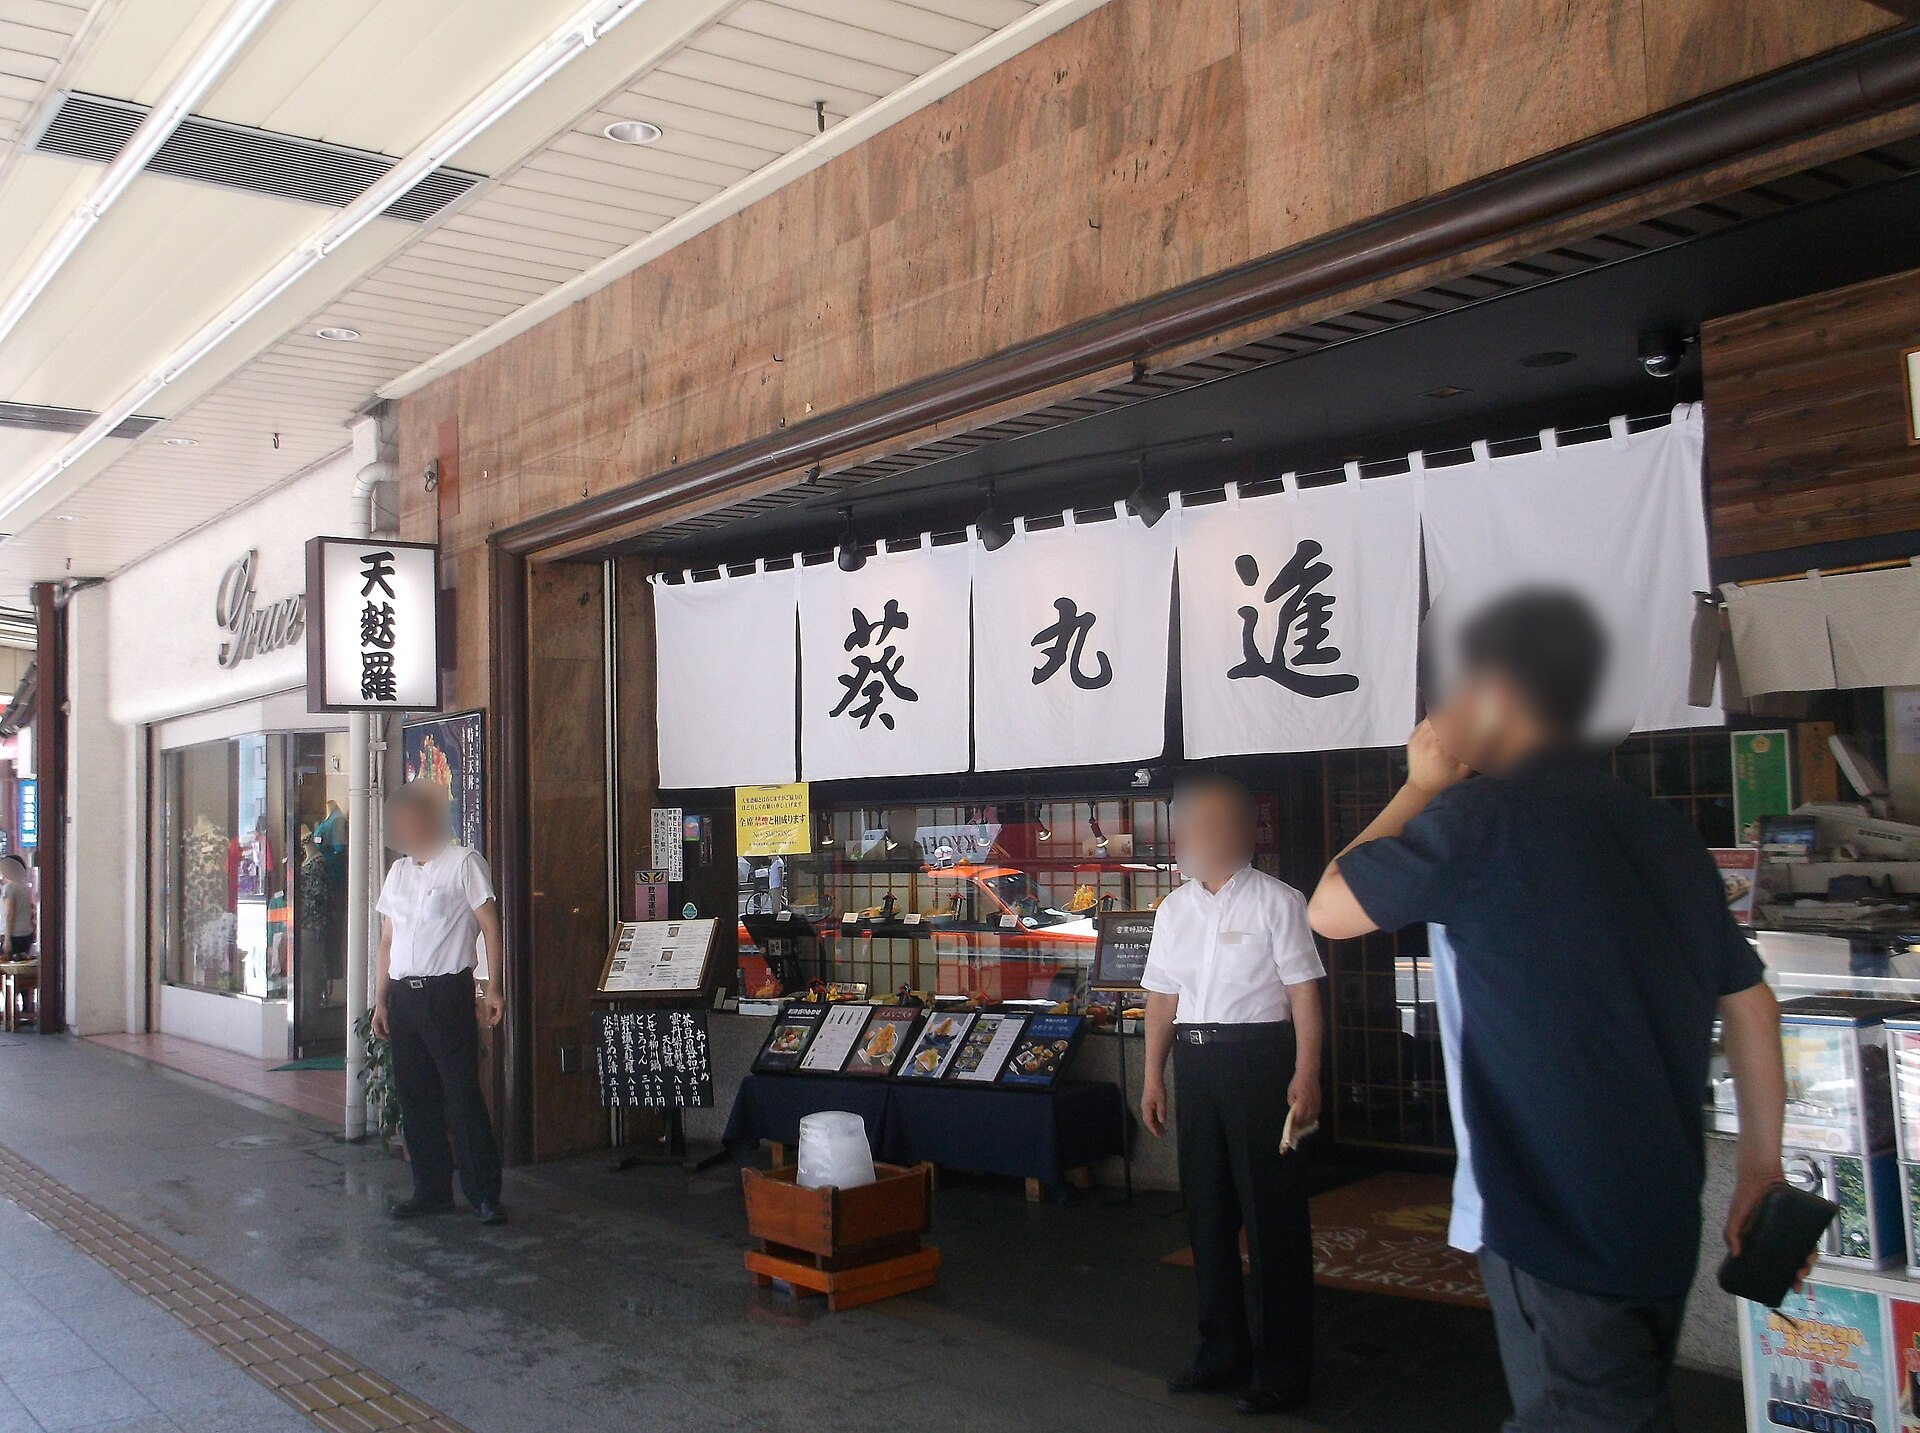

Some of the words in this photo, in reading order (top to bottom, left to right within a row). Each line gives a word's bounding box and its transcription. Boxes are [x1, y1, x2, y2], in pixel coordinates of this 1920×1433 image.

[216, 547, 306, 670] Grace
[359, 550, 397, 702] 天麩羅
[828, 538, 1360, 732] 葵丸進
[739, 813, 806, 827] 全席禁煙と相成ります
[647, 886, 656, 921] 飲酒運転
[636, 1014, 648, 1066] ところてん
[695, 1028, 711, 1082] おすすめ
